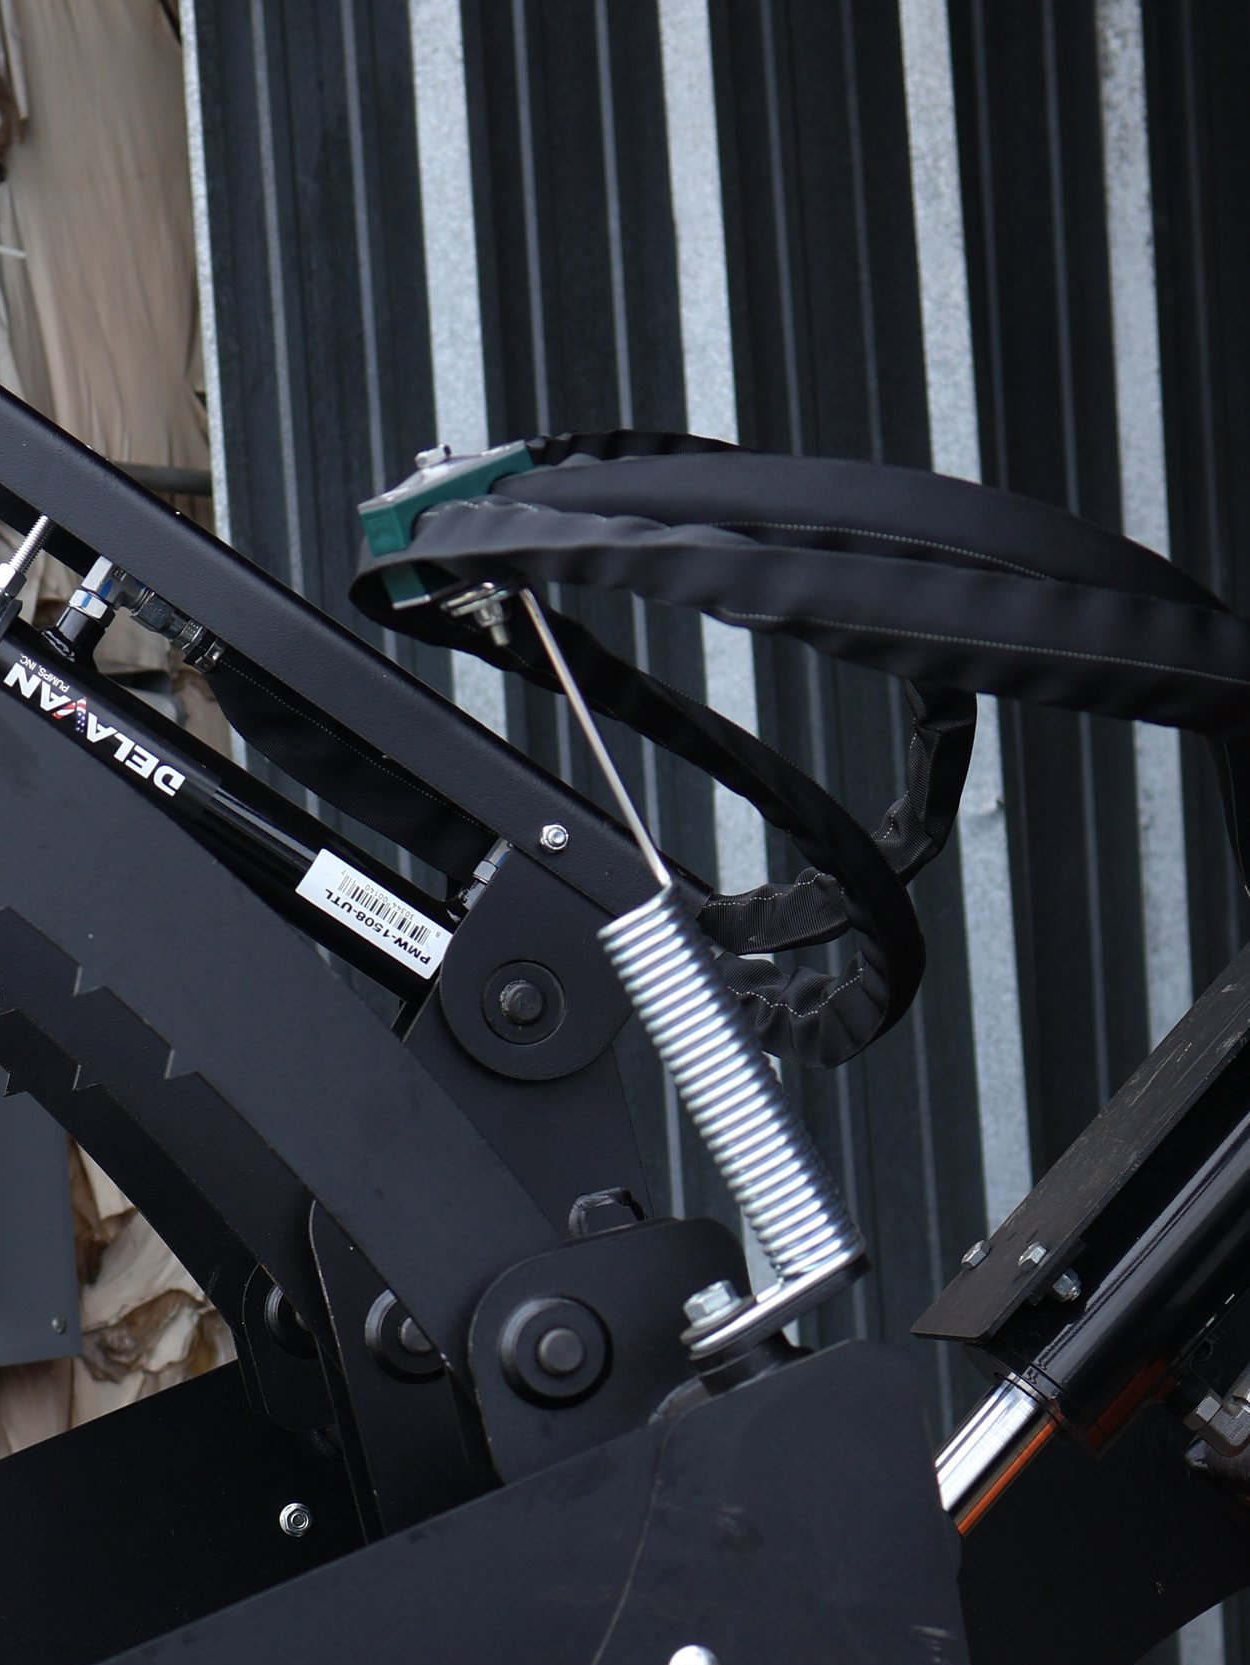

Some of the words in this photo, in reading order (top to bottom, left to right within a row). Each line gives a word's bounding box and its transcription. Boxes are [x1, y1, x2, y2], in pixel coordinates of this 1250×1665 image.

[19, 653, 37, 670] INC.
[38, 665, 70, 693] PUMPS,
[3, 662, 186, 797] DELAVAN
[364, 884, 389, 903] 00140
[392, 902, 415, 920] 30344
[325, 888, 432, 965] PMW-1508-UTL
